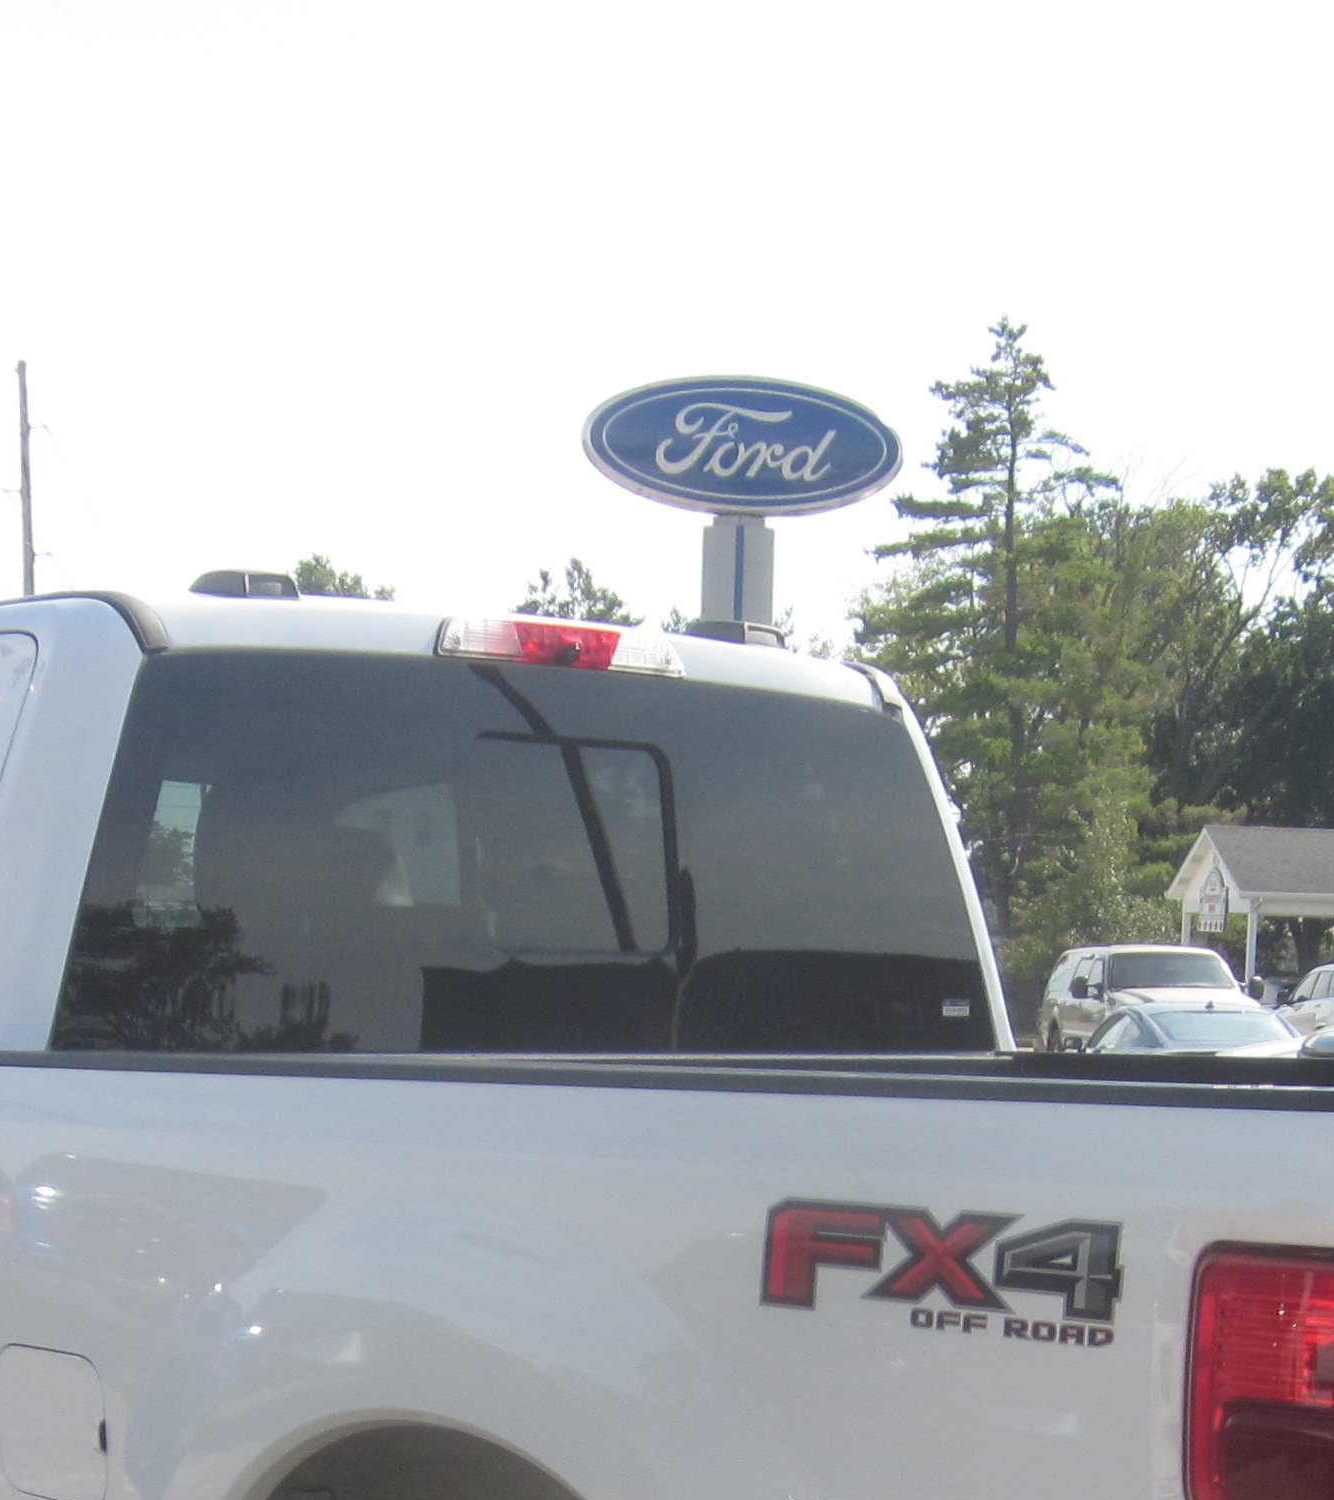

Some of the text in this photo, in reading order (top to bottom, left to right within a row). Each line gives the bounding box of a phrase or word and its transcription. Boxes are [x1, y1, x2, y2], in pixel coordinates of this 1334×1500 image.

[654, 401, 838, 482] Ford
[759, 1196, 1126, 1325] FX4
[909, 1307, 1116, 1348] OFF ROAD
